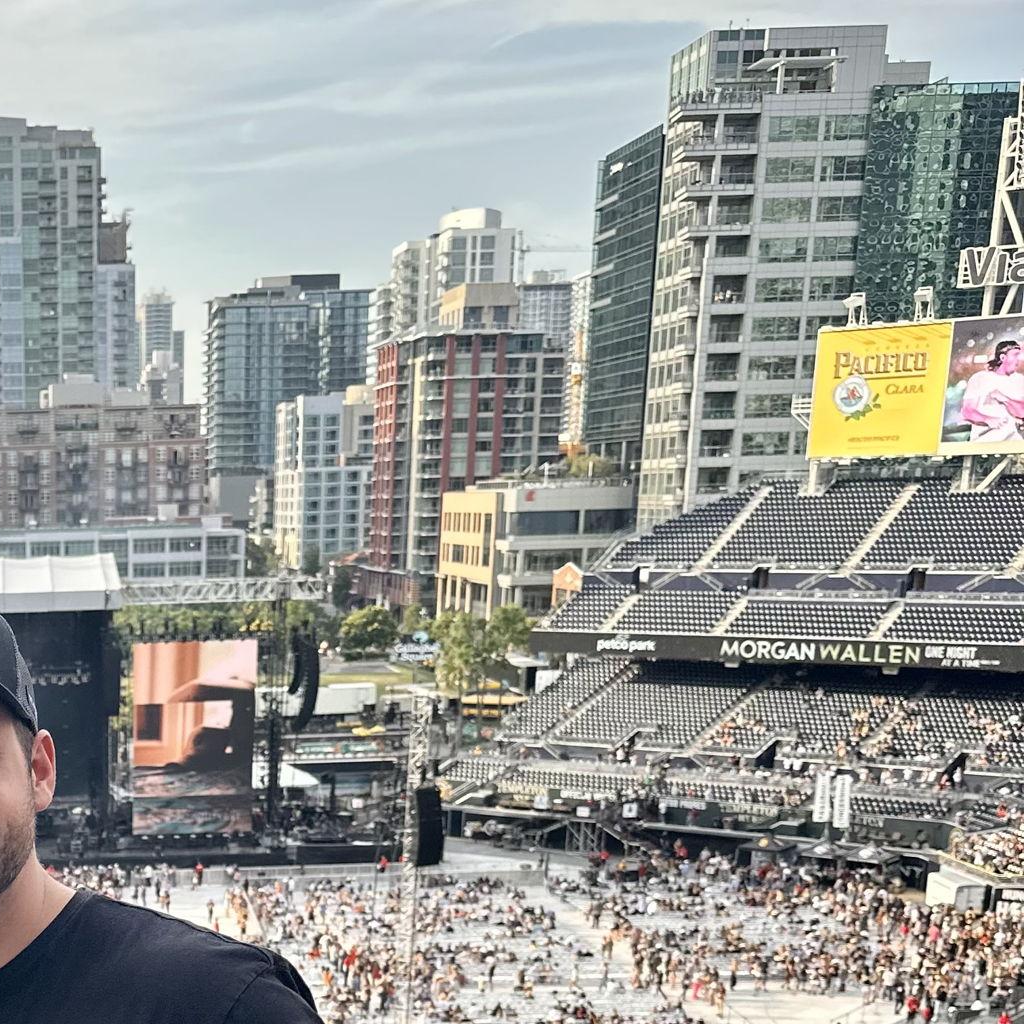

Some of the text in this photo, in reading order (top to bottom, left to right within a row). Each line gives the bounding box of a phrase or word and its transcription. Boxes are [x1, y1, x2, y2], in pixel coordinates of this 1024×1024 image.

[833, 351, 927, 379] PACIFICO
[885, 383, 925, 395] CLARA
[596, 638, 656, 653] petco park
[720, 640, 921, 664] MORGAN WALLEN
[924, 645, 978, 660] ONE NIGHT
